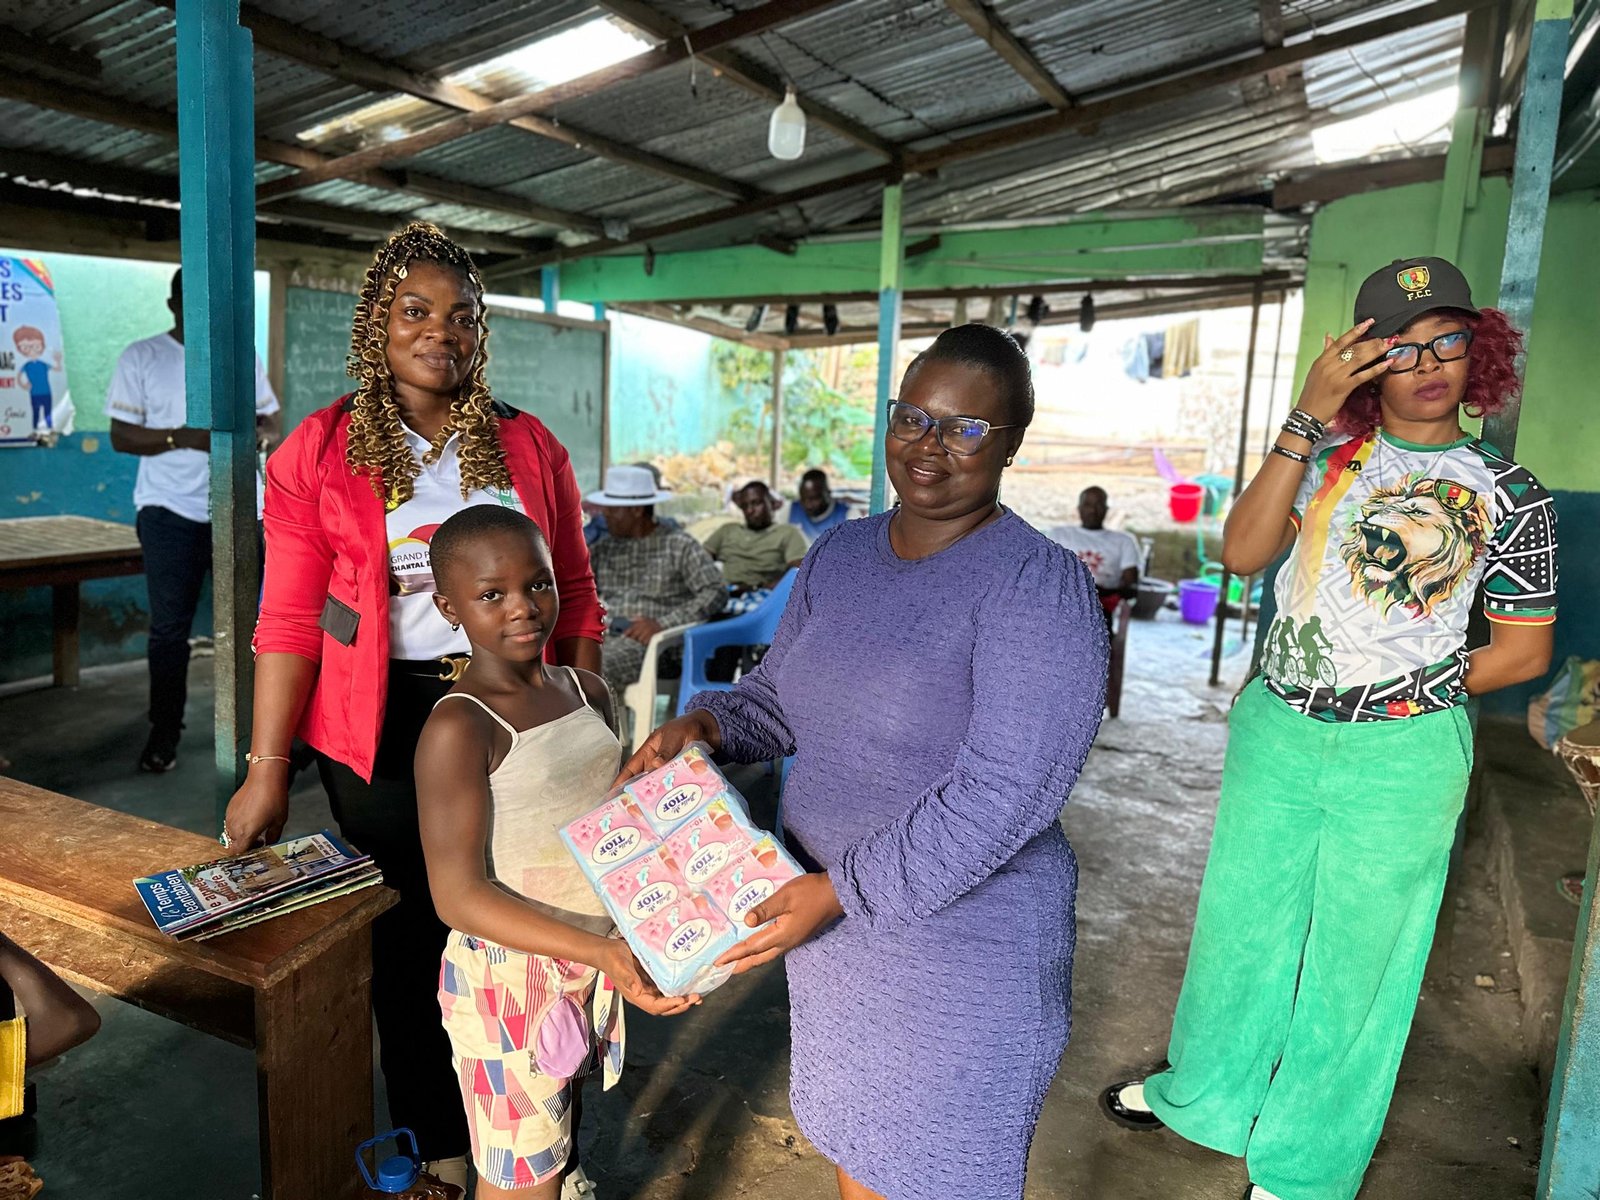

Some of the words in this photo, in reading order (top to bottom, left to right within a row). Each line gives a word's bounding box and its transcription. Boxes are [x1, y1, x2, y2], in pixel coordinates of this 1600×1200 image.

[391, 552, 422, 564] GRAND
[391, 562, 425, 571] CHANTAL
[661, 792, 688, 812] TIOF
[598, 835, 626, 856] TIOF
[689, 852, 715, 875] TIOF
[149, 882, 175, 912] Temps
[635, 890, 663, 911] TIOF
[733, 889, 759, 913] TIOF
[670, 928, 697, 953] TIOF
